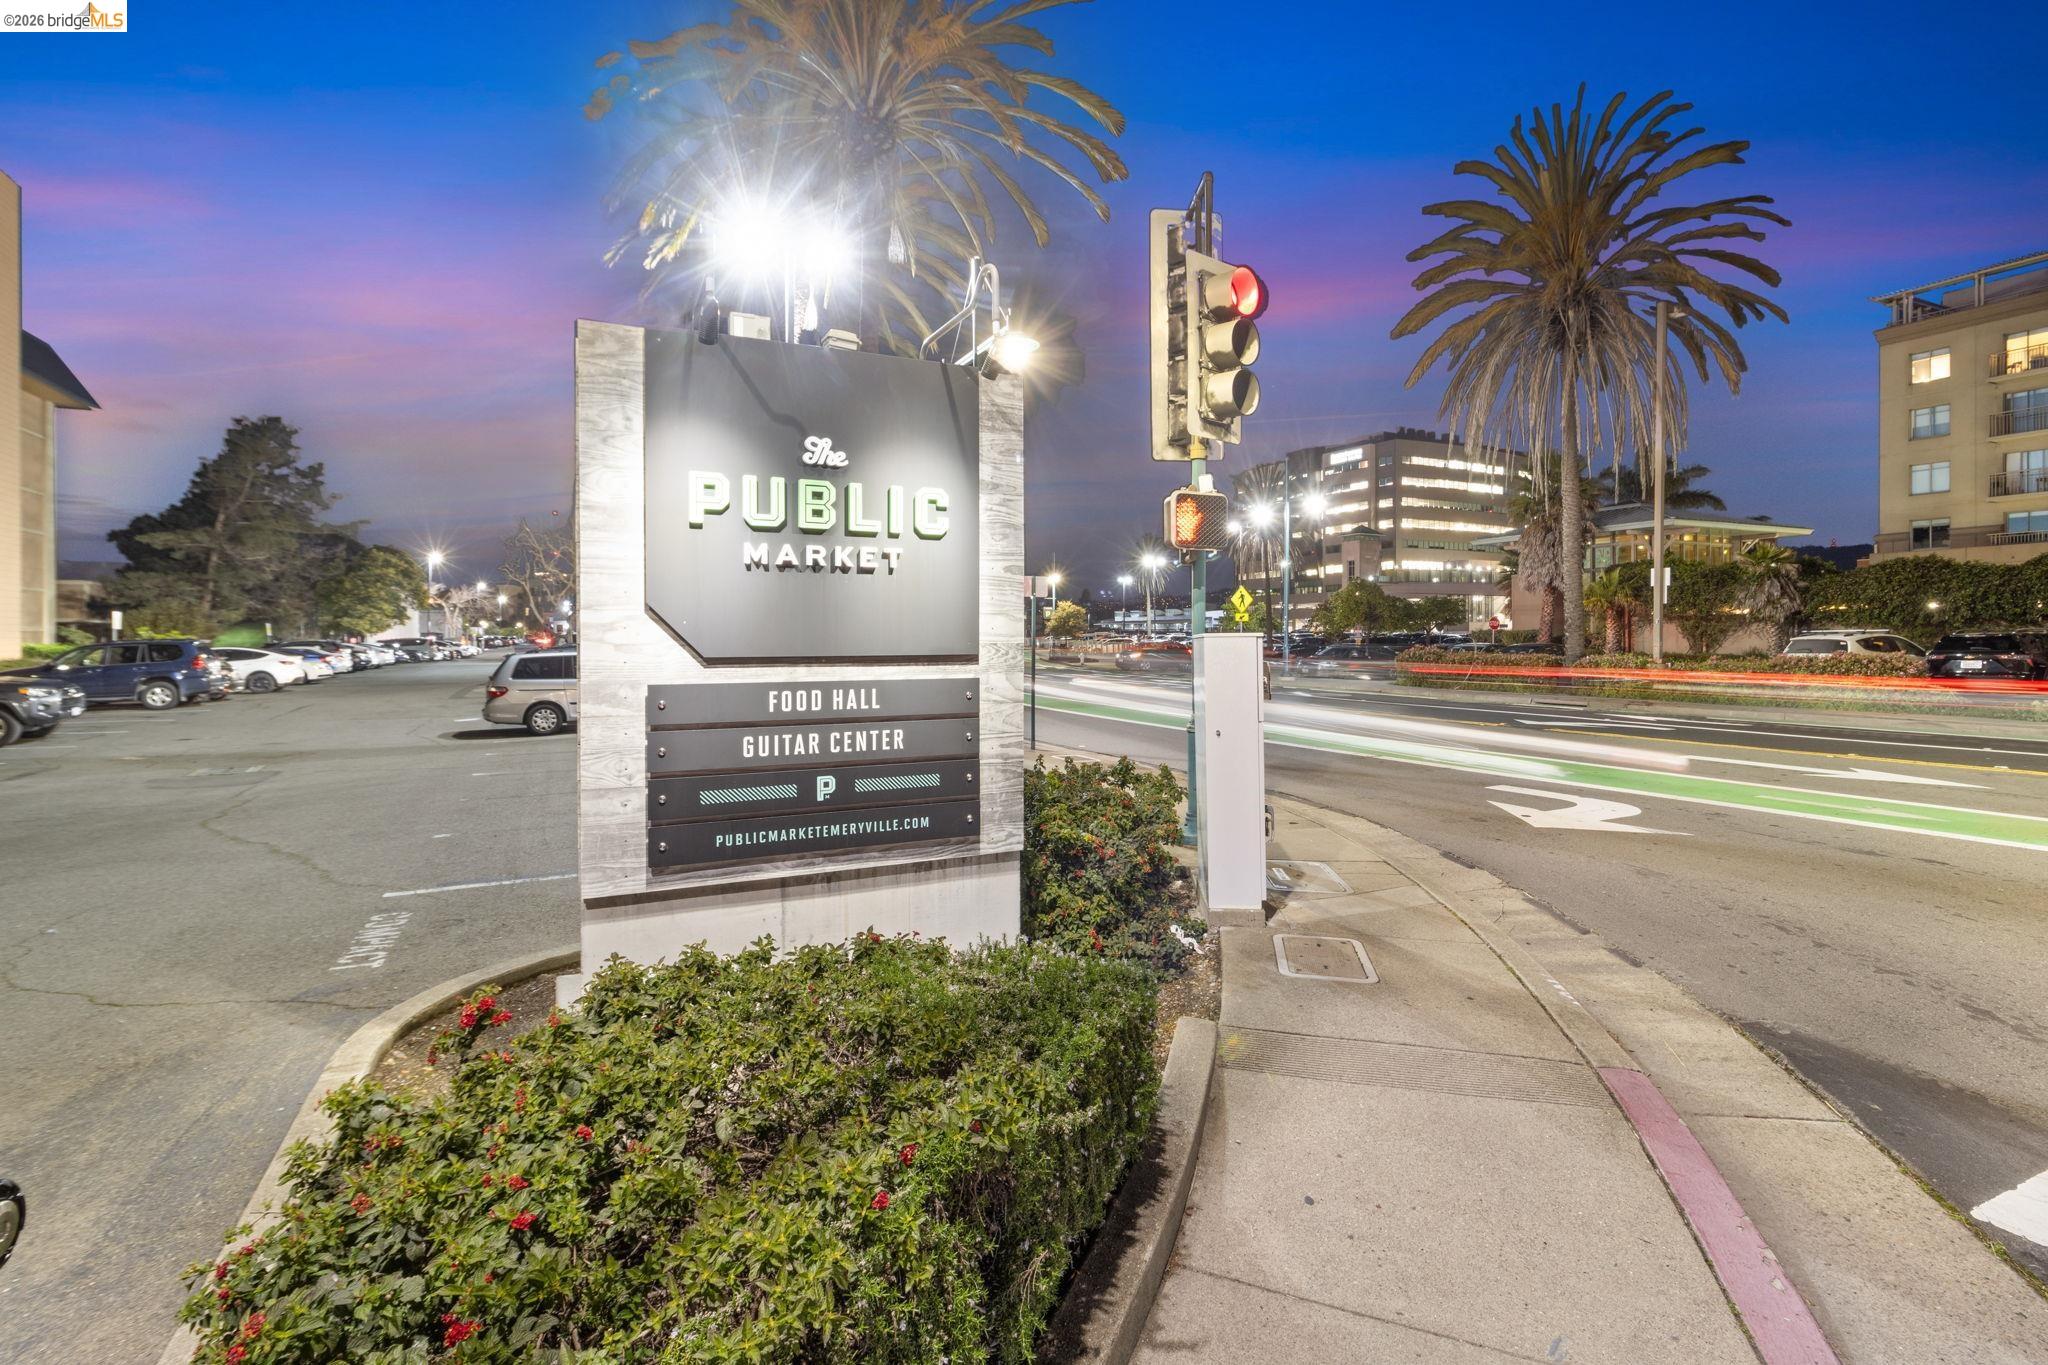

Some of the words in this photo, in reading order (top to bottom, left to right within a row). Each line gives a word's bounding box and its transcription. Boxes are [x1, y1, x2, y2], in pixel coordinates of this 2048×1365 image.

[802, 435, 849, 467] The
[688, 470, 950, 541] PUBLIC
[743, 543, 904, 575] MARKET
[768, 690, 822, 713] FOOD
[832, 688, 880, 710] HALL
[743, 732, 820, 758] GUITAR
[830, 729, 904, 753] CENTER
[716, 816, 929, 848] PUBLICMARKETEMERYVILLE.COM
